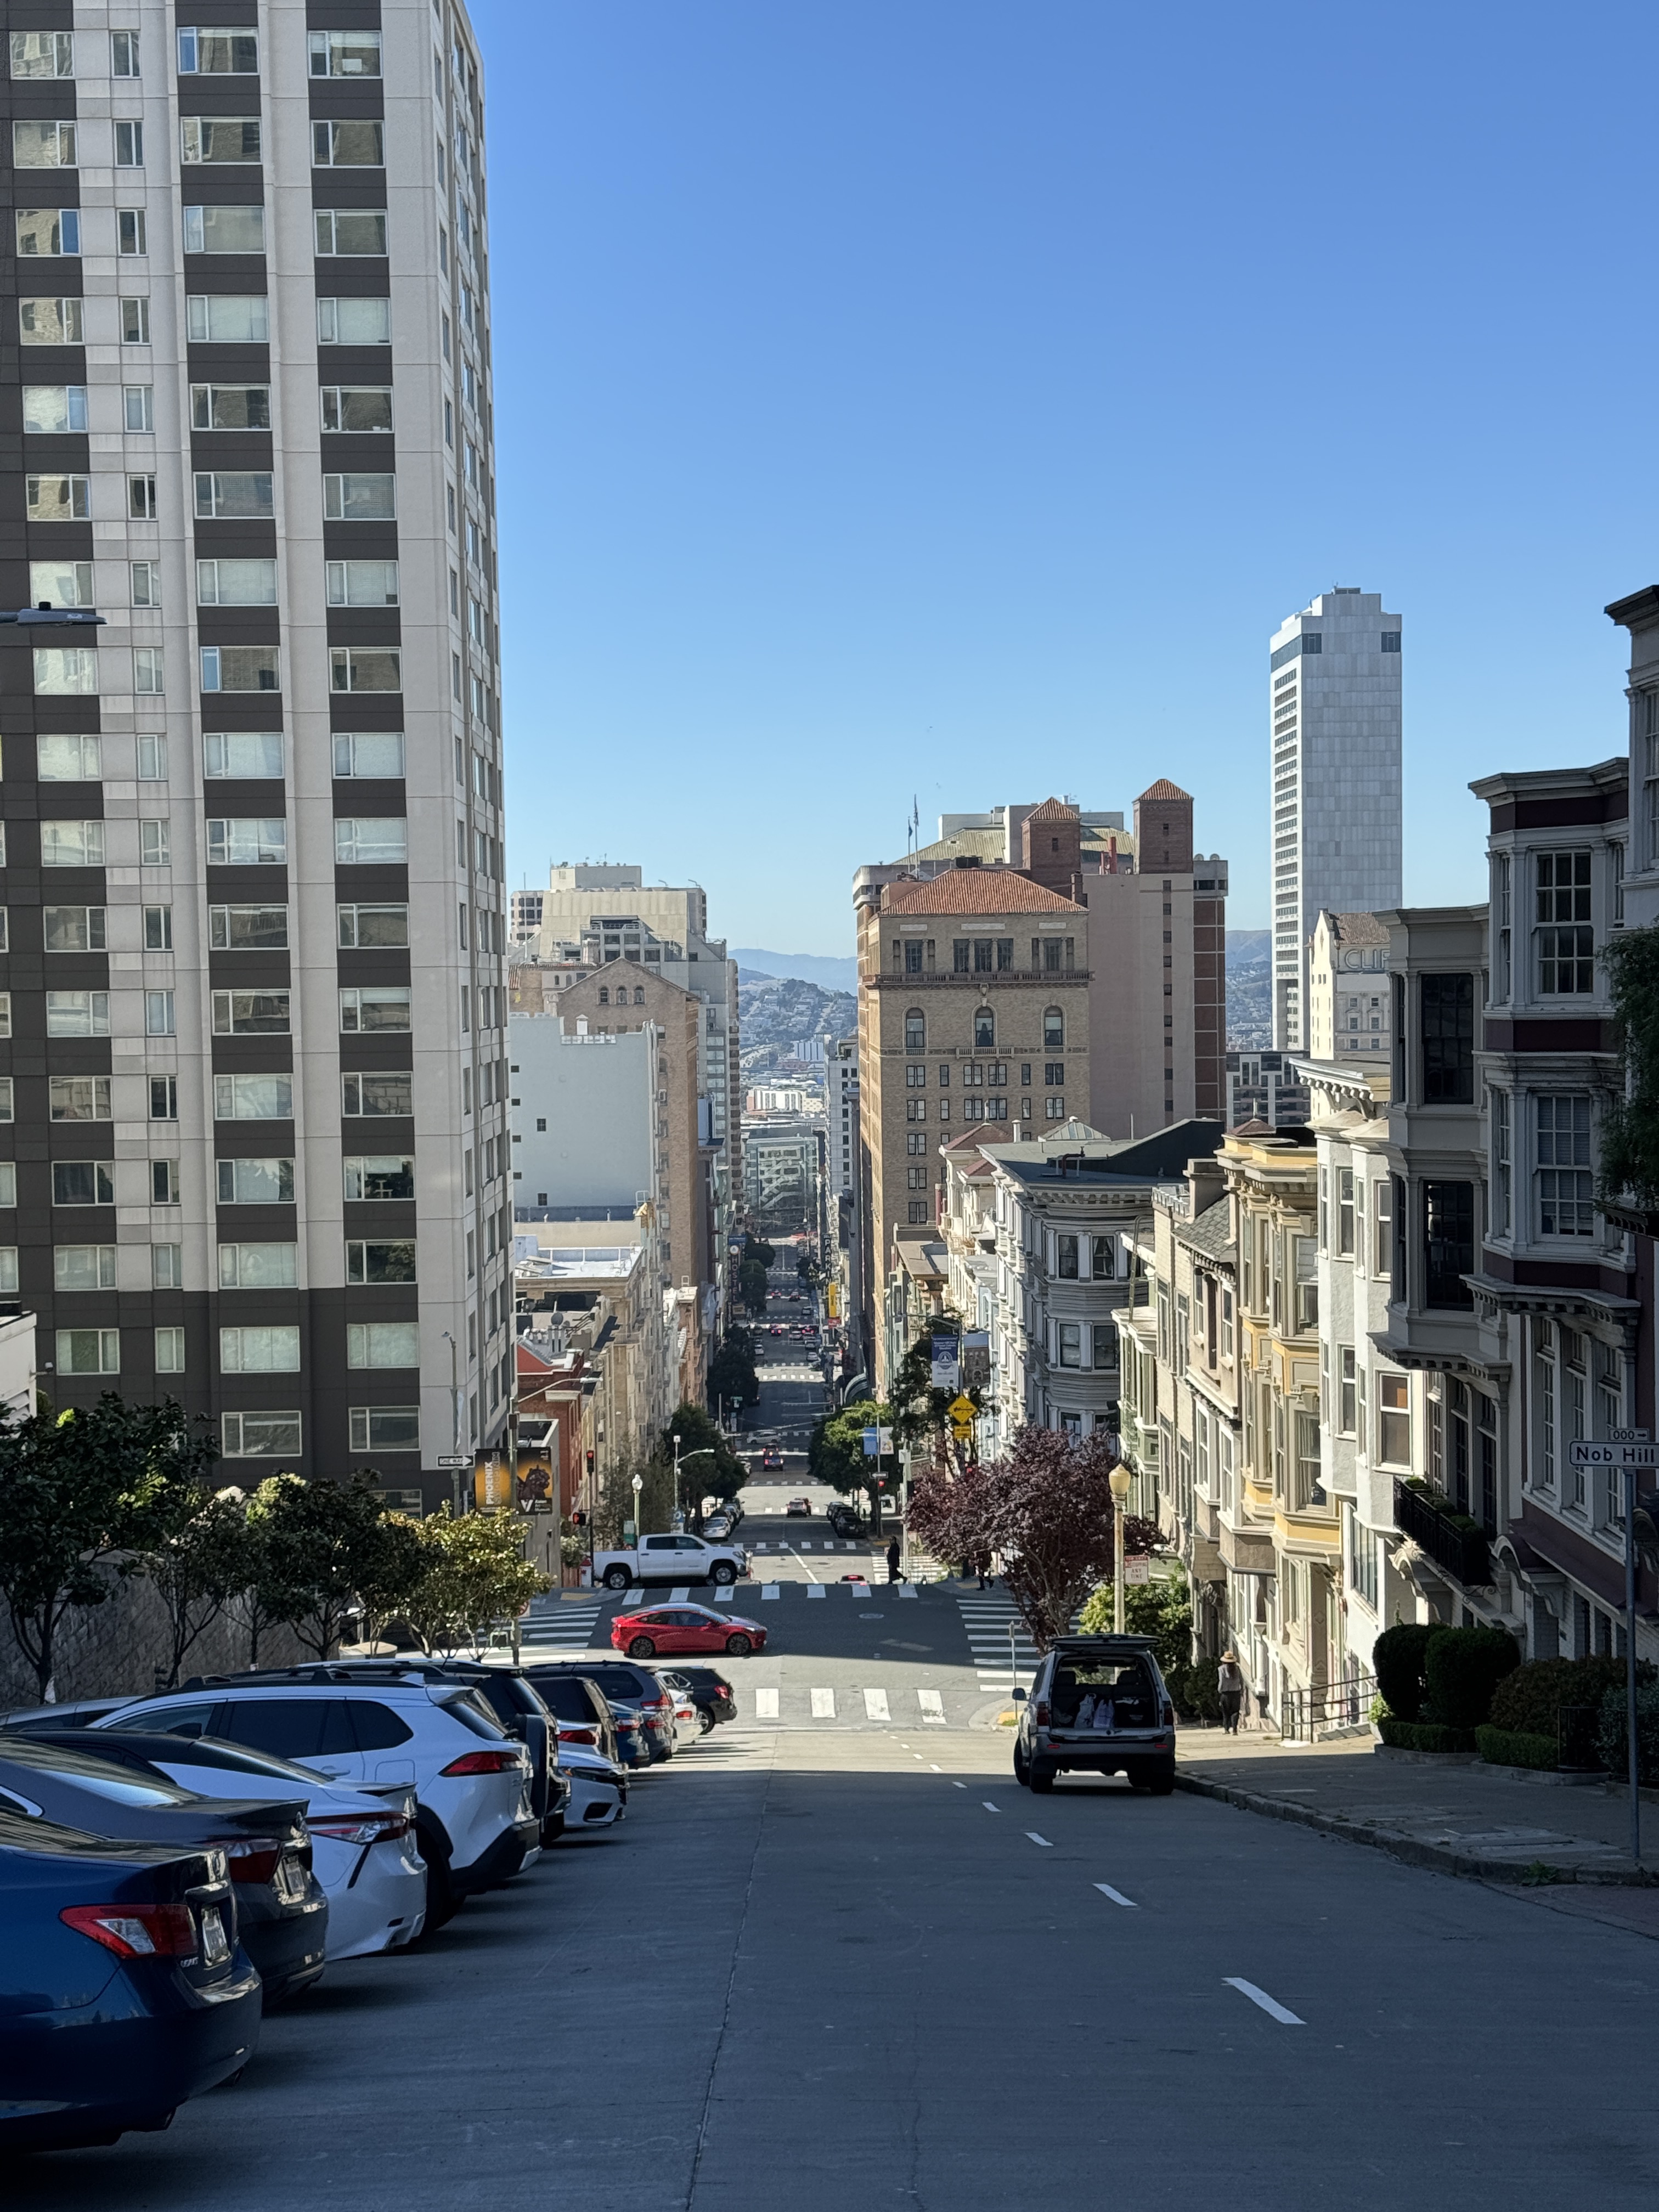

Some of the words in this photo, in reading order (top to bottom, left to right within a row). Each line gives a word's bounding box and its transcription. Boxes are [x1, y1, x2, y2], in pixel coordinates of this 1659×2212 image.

[1613, 1430, 1635, 1440] 000
[1576, 1447, 1613, 1462] Nob
[1623, 1448, 1654, 1463] Hill
[484, 1462, 494, 1505] PHOENIX
